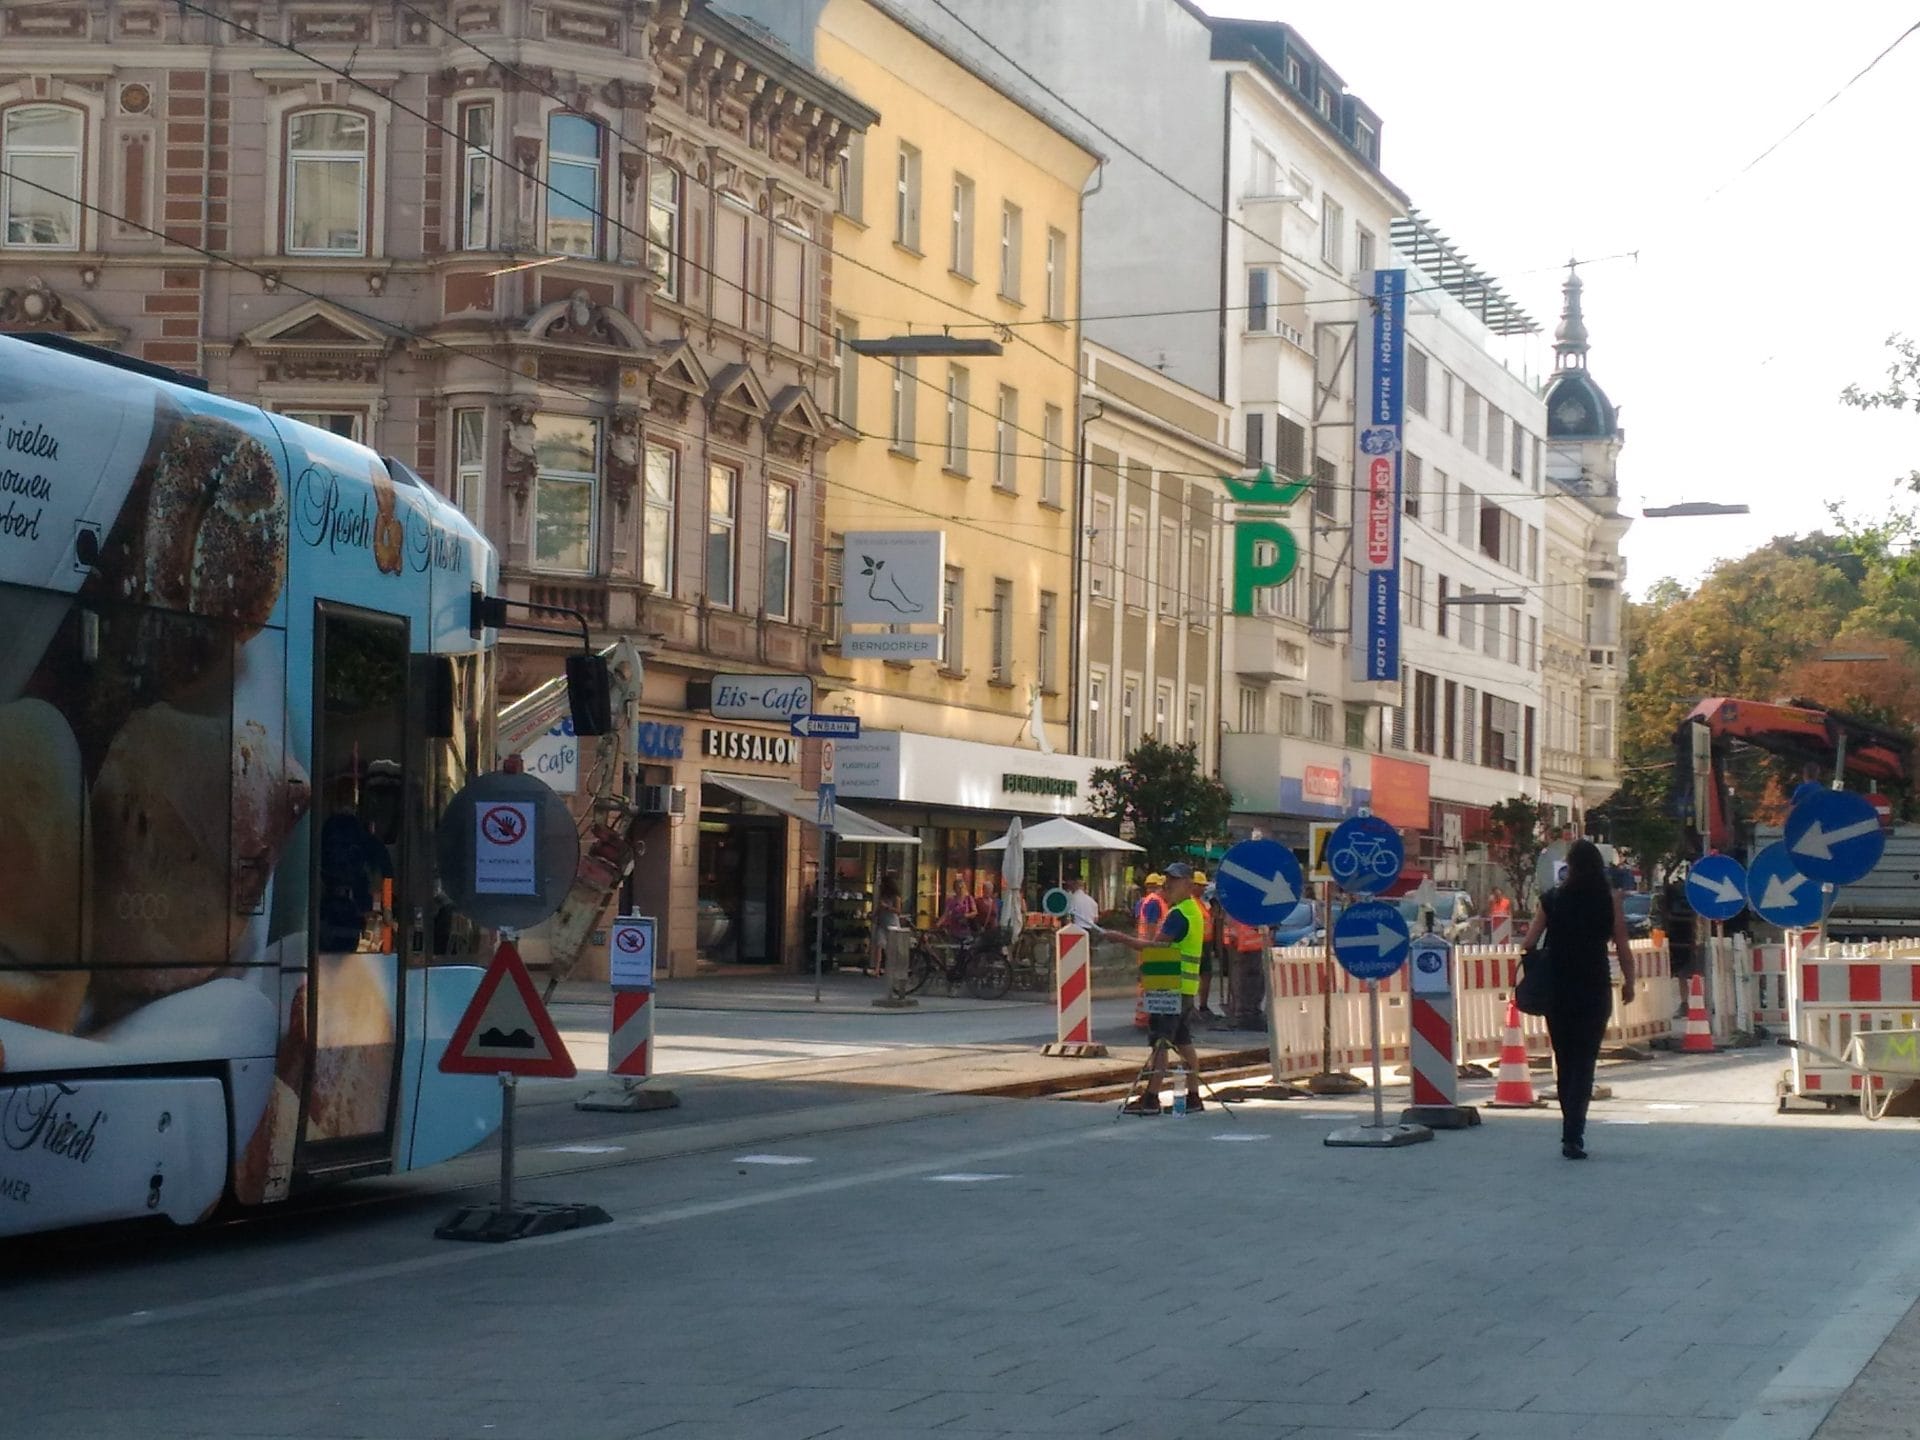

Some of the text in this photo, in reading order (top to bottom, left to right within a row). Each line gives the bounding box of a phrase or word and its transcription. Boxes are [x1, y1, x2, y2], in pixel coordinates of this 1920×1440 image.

[1381, 376, 1391, 421] OPTIK
[6, 420, 59, 461] vielen
[1233, 520, 1301, 617] P
[1376, 575, 1387, 676] FOTO HANDY
[851, 641, 929, 653] BERNDORFER
[716, 685, 808, 716] Eis-Cafe
[806, 720, 851, 732] EINBAHN
[708, 729, 799, 764] EISSALON
